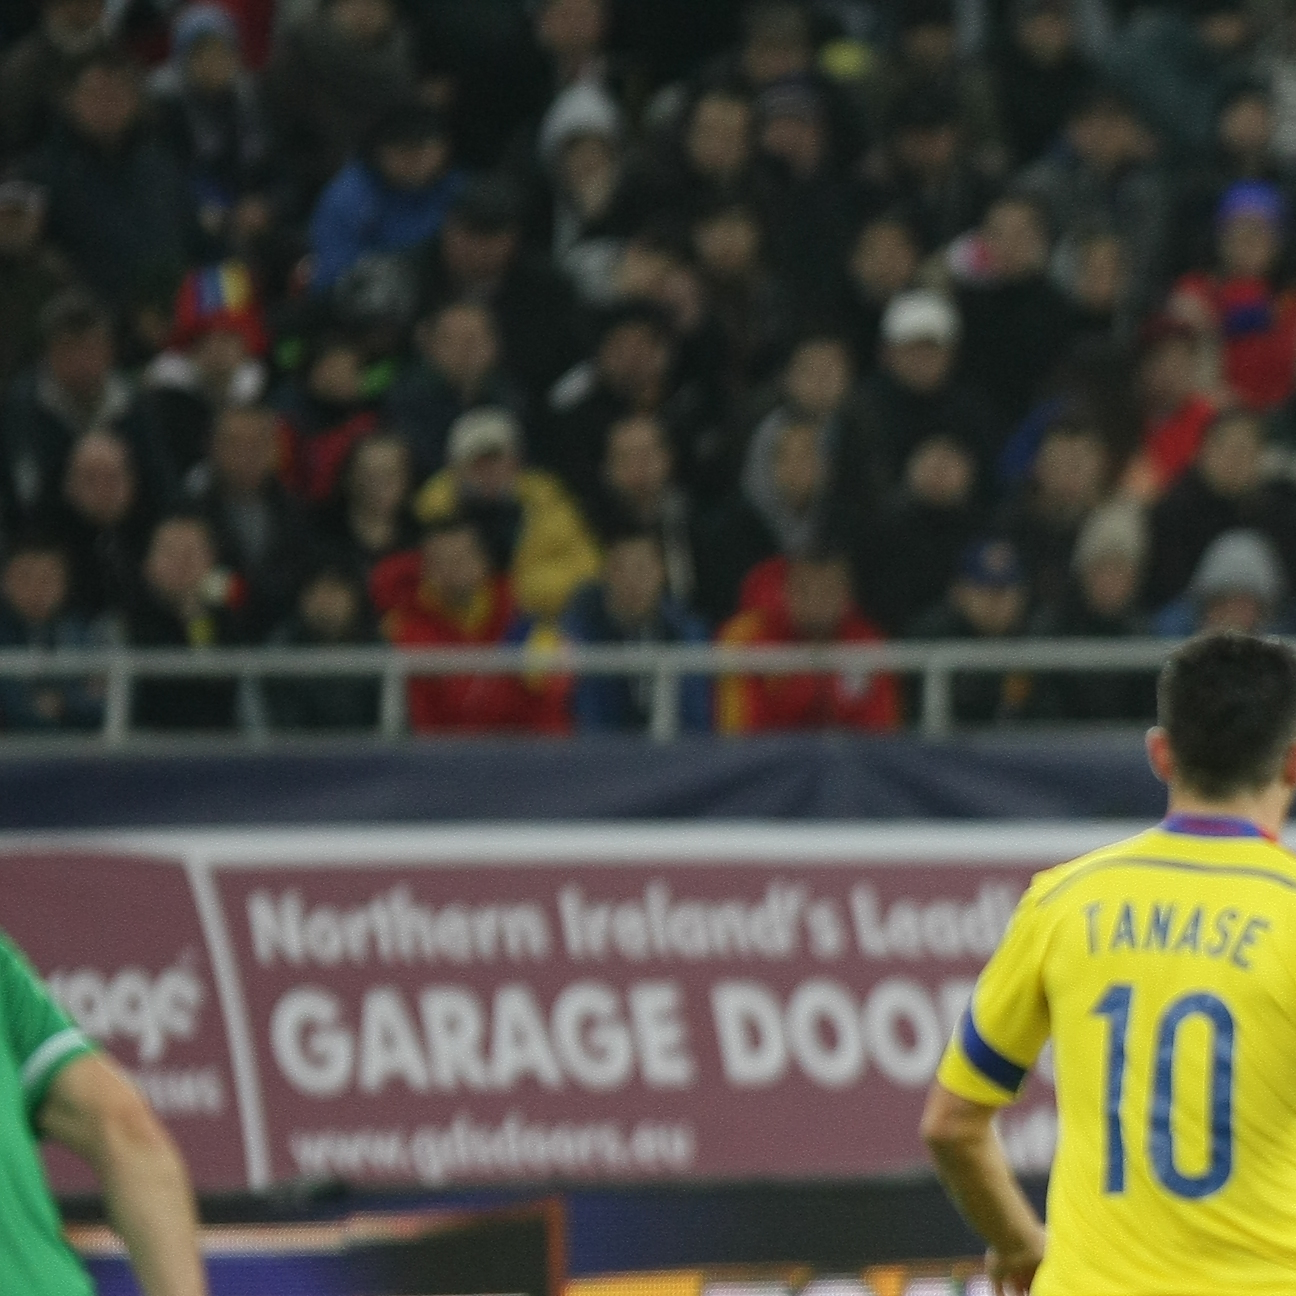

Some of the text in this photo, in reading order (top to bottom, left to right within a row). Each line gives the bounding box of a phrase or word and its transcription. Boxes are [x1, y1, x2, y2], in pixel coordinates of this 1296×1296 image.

[249, 878, 1018, 964] Northern Ireland's Lead
[1085, 902, 1271, 969] TANASE
[270, 981, 697, 1094] GARAGE
[1092, 984, 1236, 1200] 10
